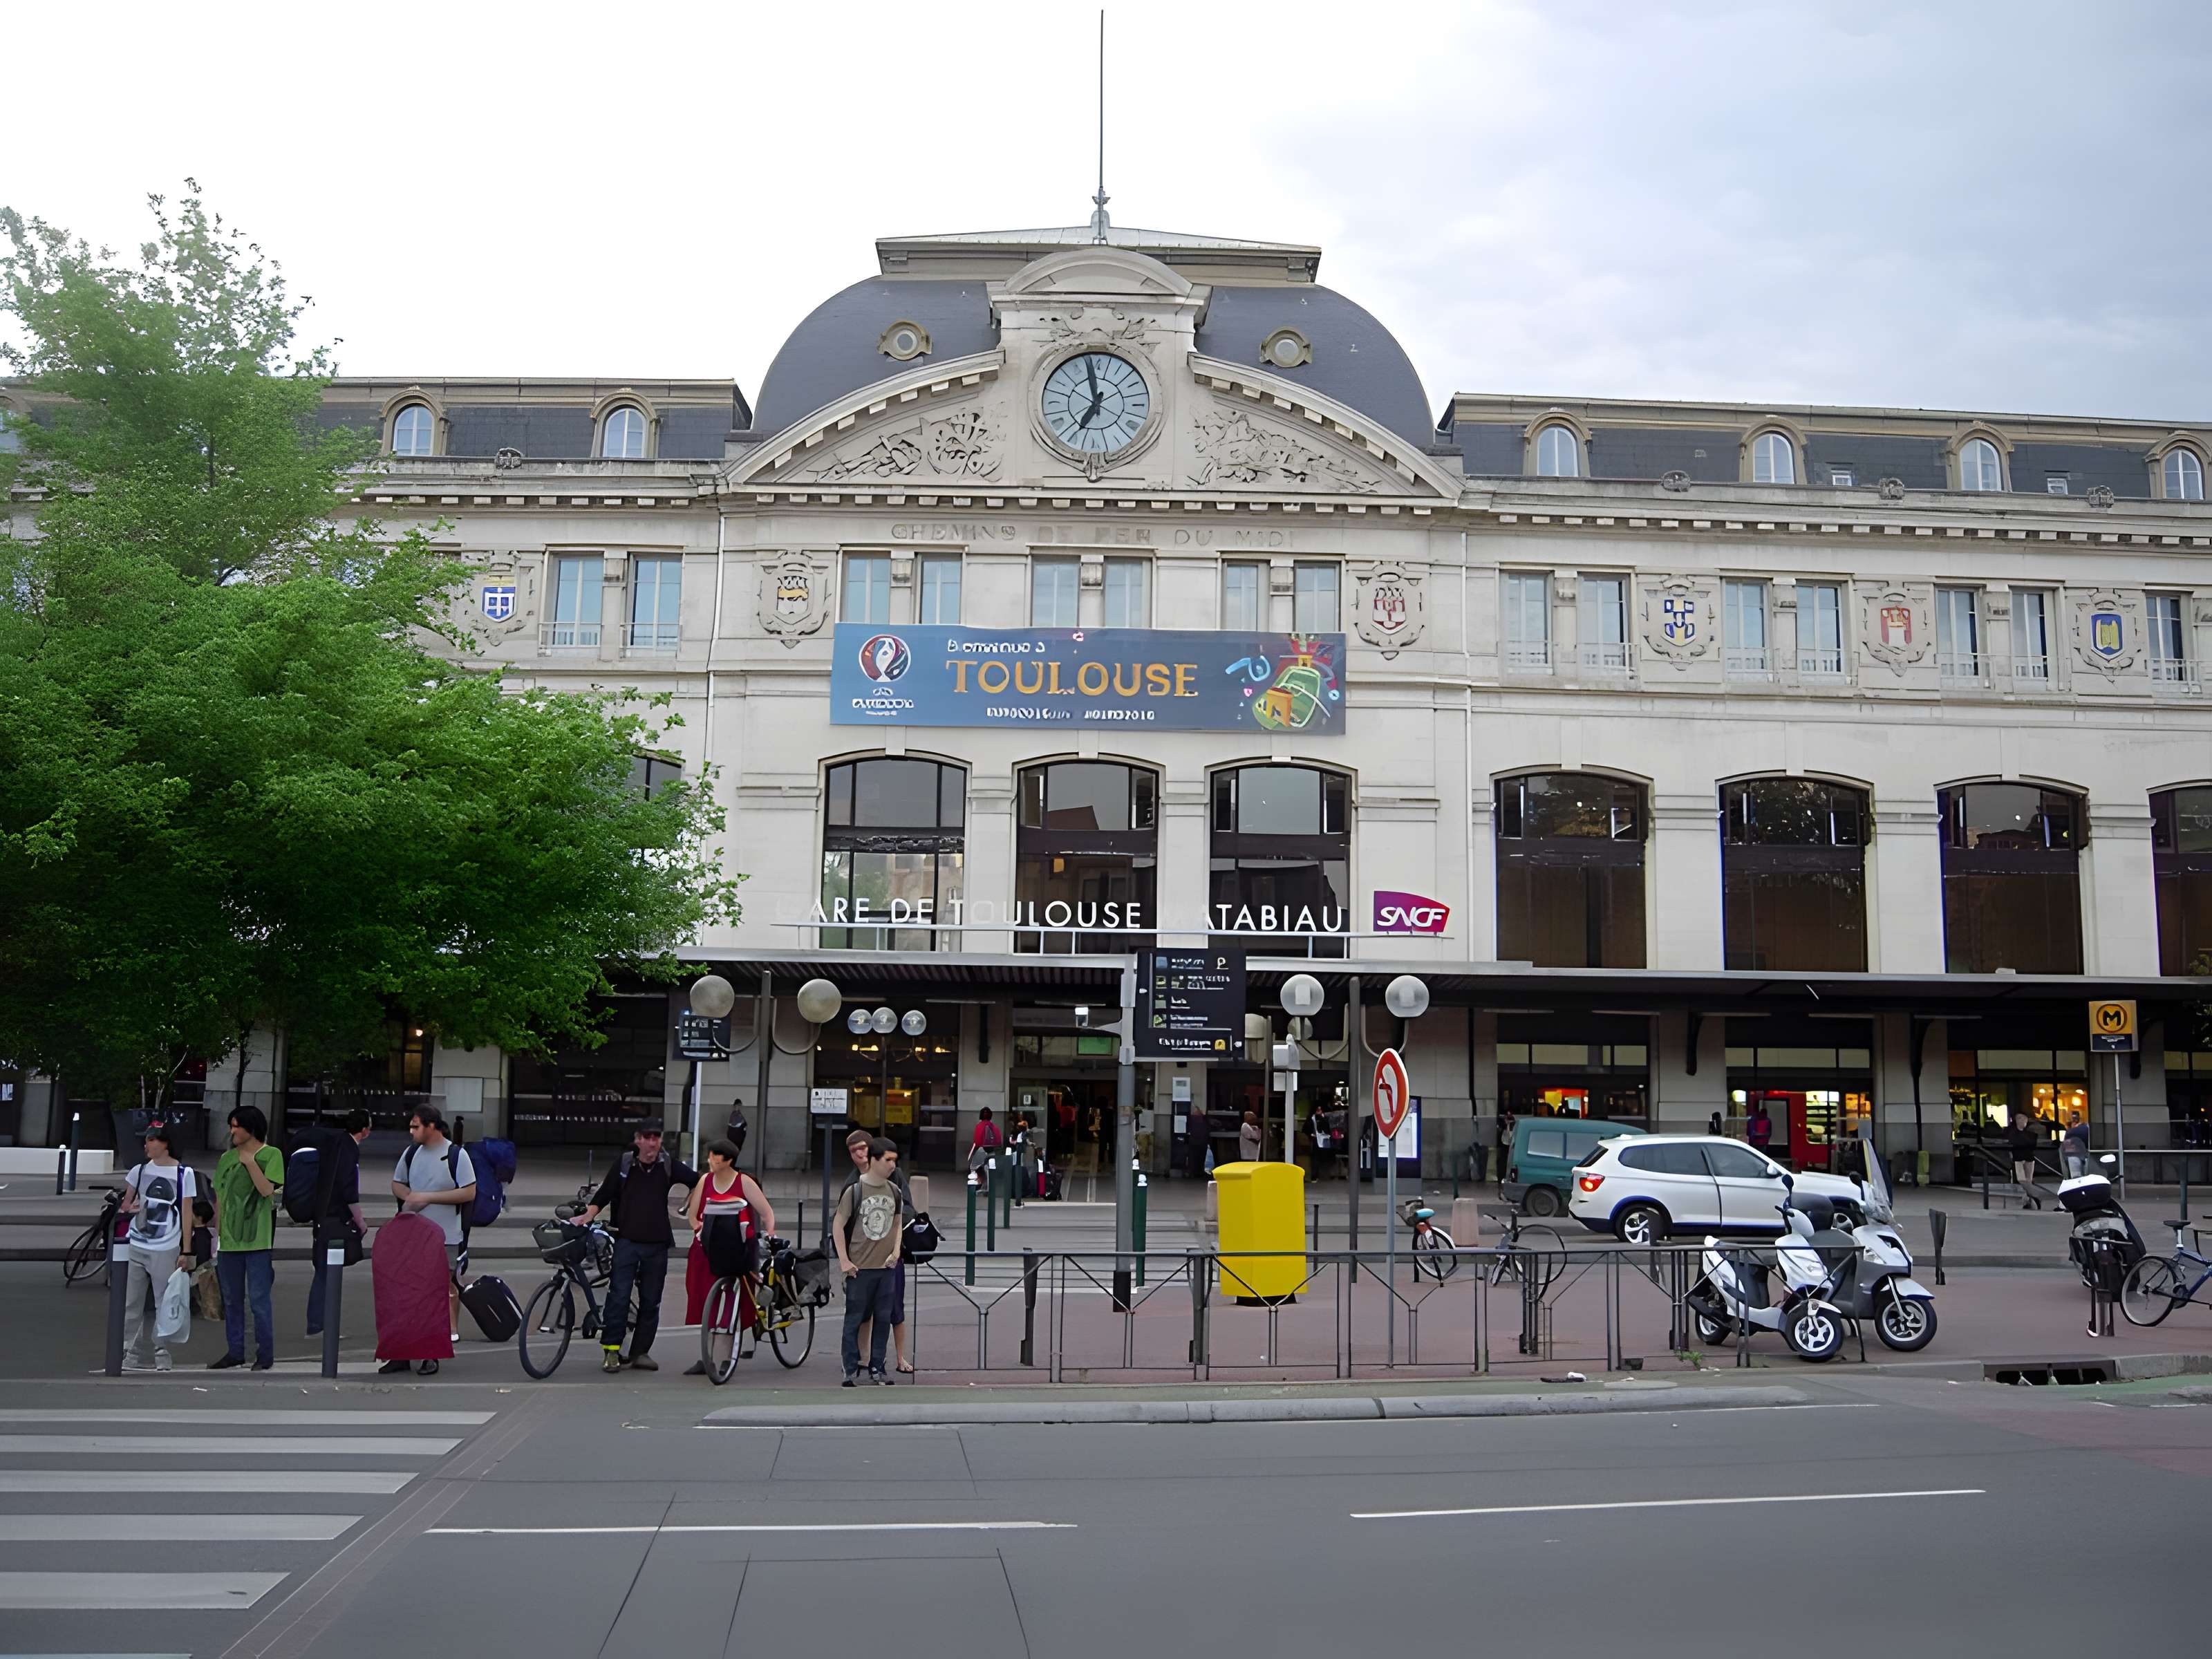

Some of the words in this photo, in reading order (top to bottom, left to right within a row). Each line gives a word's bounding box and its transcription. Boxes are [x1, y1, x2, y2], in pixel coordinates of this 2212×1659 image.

[946, 660, 1199, 697] TOULOUSE
[891, 897, 934, 924] DE
[948, 899, 1141, 928] TOULOUSE
[1376, 906, 1446, 927] SNCF
[2102, 1009, 2121, 1027] M
